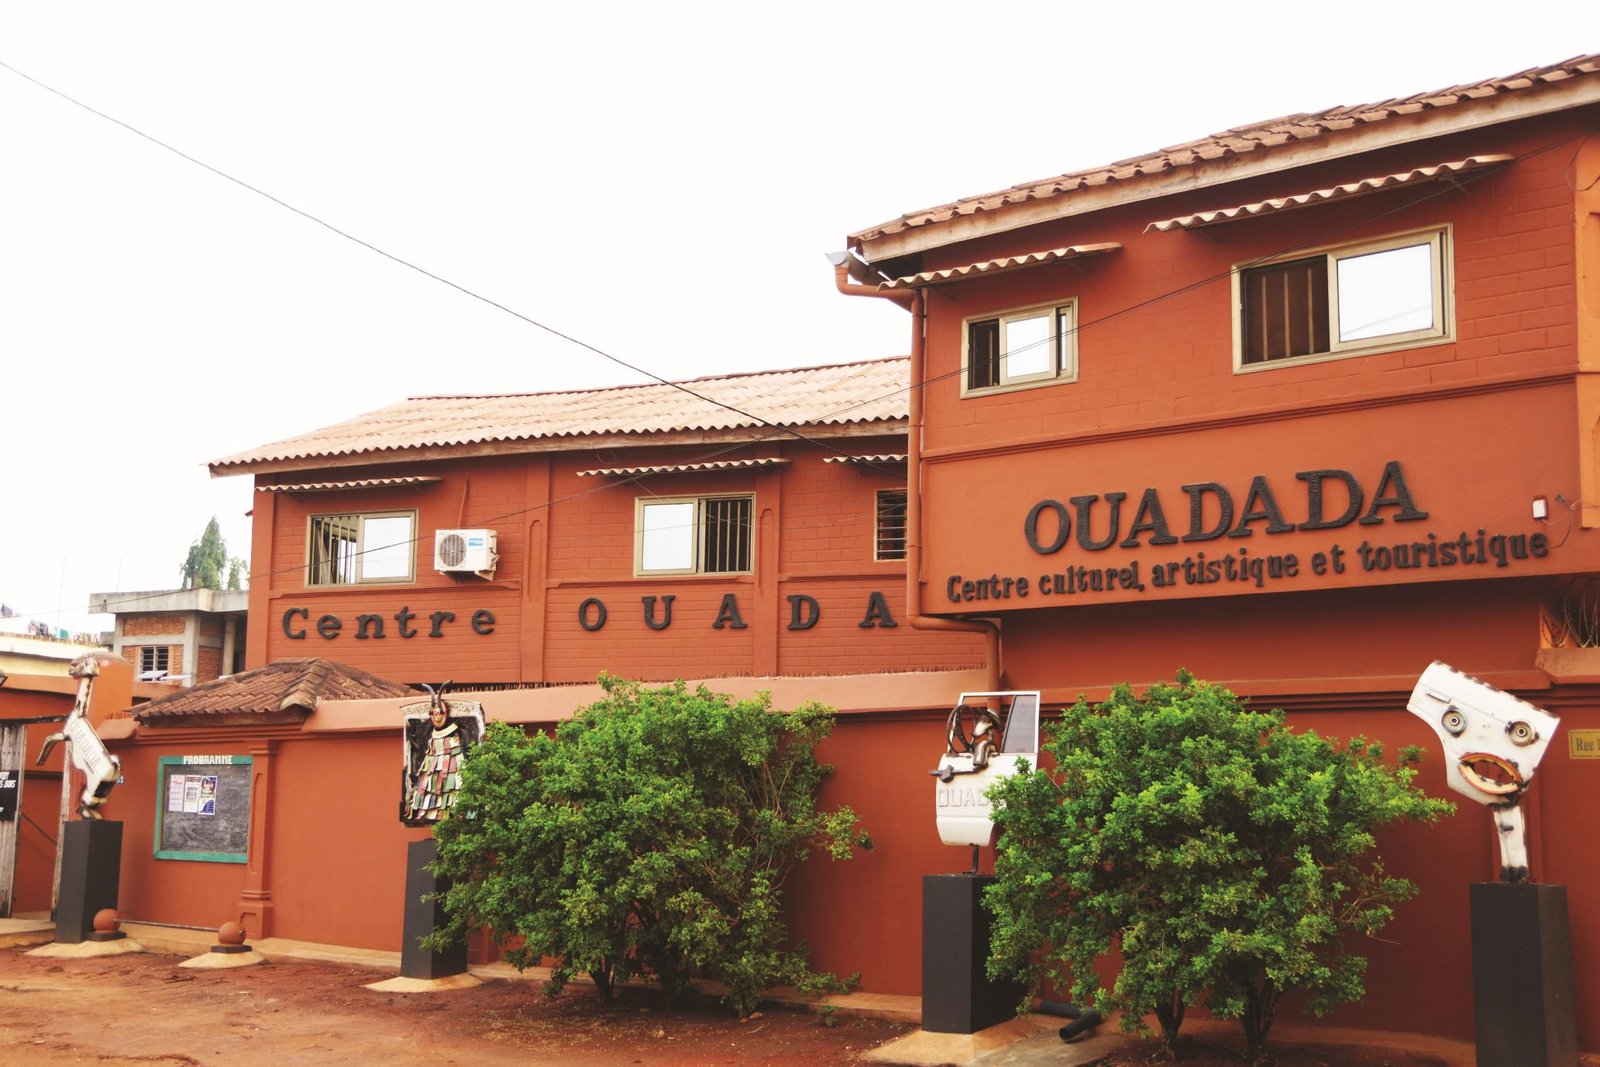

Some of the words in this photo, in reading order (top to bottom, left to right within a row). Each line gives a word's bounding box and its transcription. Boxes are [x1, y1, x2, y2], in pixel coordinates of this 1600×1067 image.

[1024, 460, 1428, 555] OUADADA
[947, 573, 1029, 602] Centre
[1152, 547, 1299, 588] artistique
[1311, 544, 1345, 575] et
[1357, 528, 1548, 571] touristique
[282, 606, 496, 639] Centre
[183, 755, 233, 765] PROGRAMME
[1576, 737, 1594, 752] Rue
